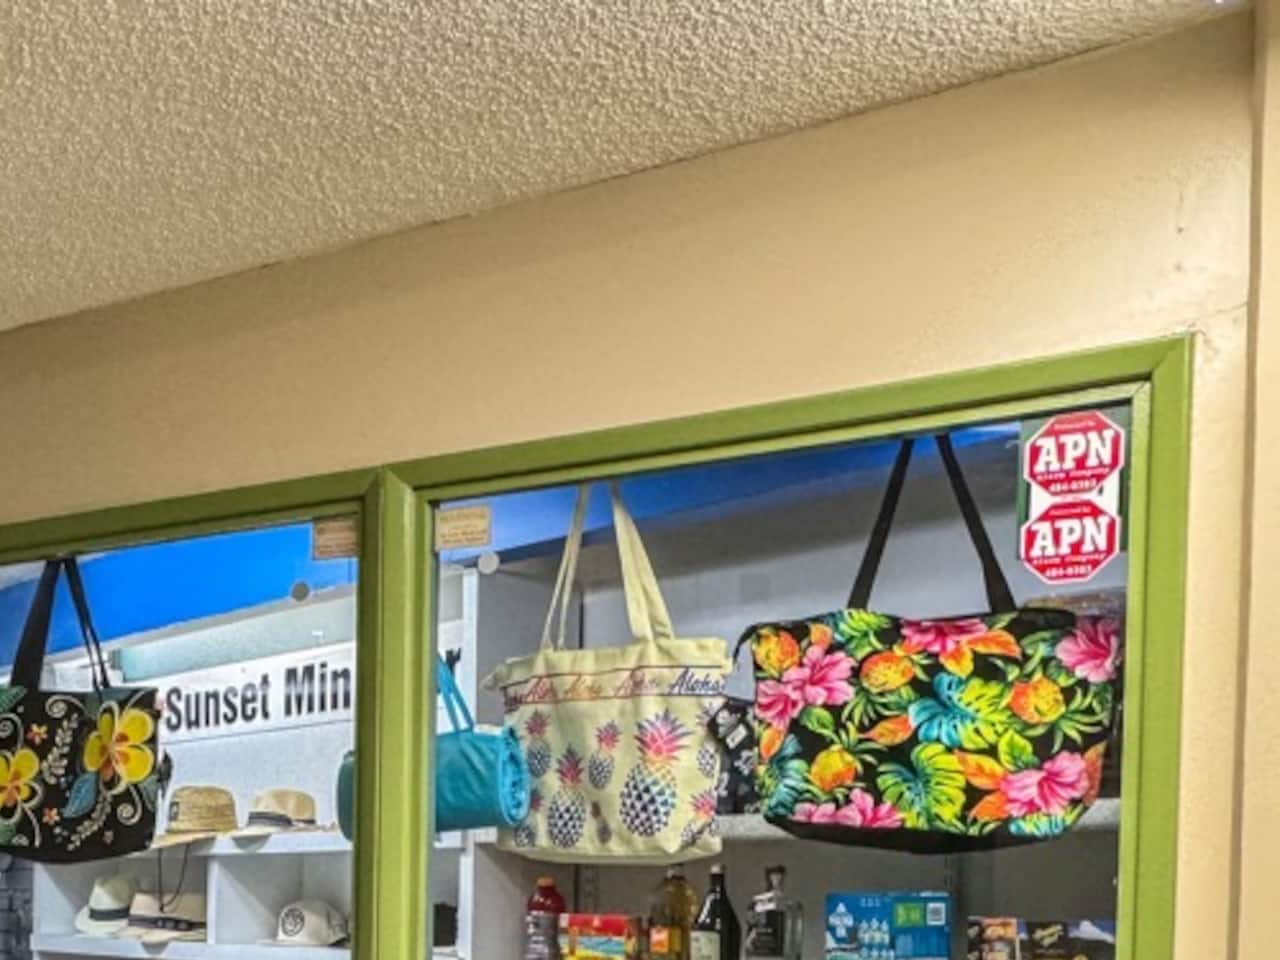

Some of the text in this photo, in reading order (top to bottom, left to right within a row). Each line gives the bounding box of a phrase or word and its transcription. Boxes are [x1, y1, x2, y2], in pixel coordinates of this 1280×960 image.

[1033, 428, 1115, 474] APN
[1029, 515, 1111, 557] APN
[165, 661, 353, 733] Sunset Min
